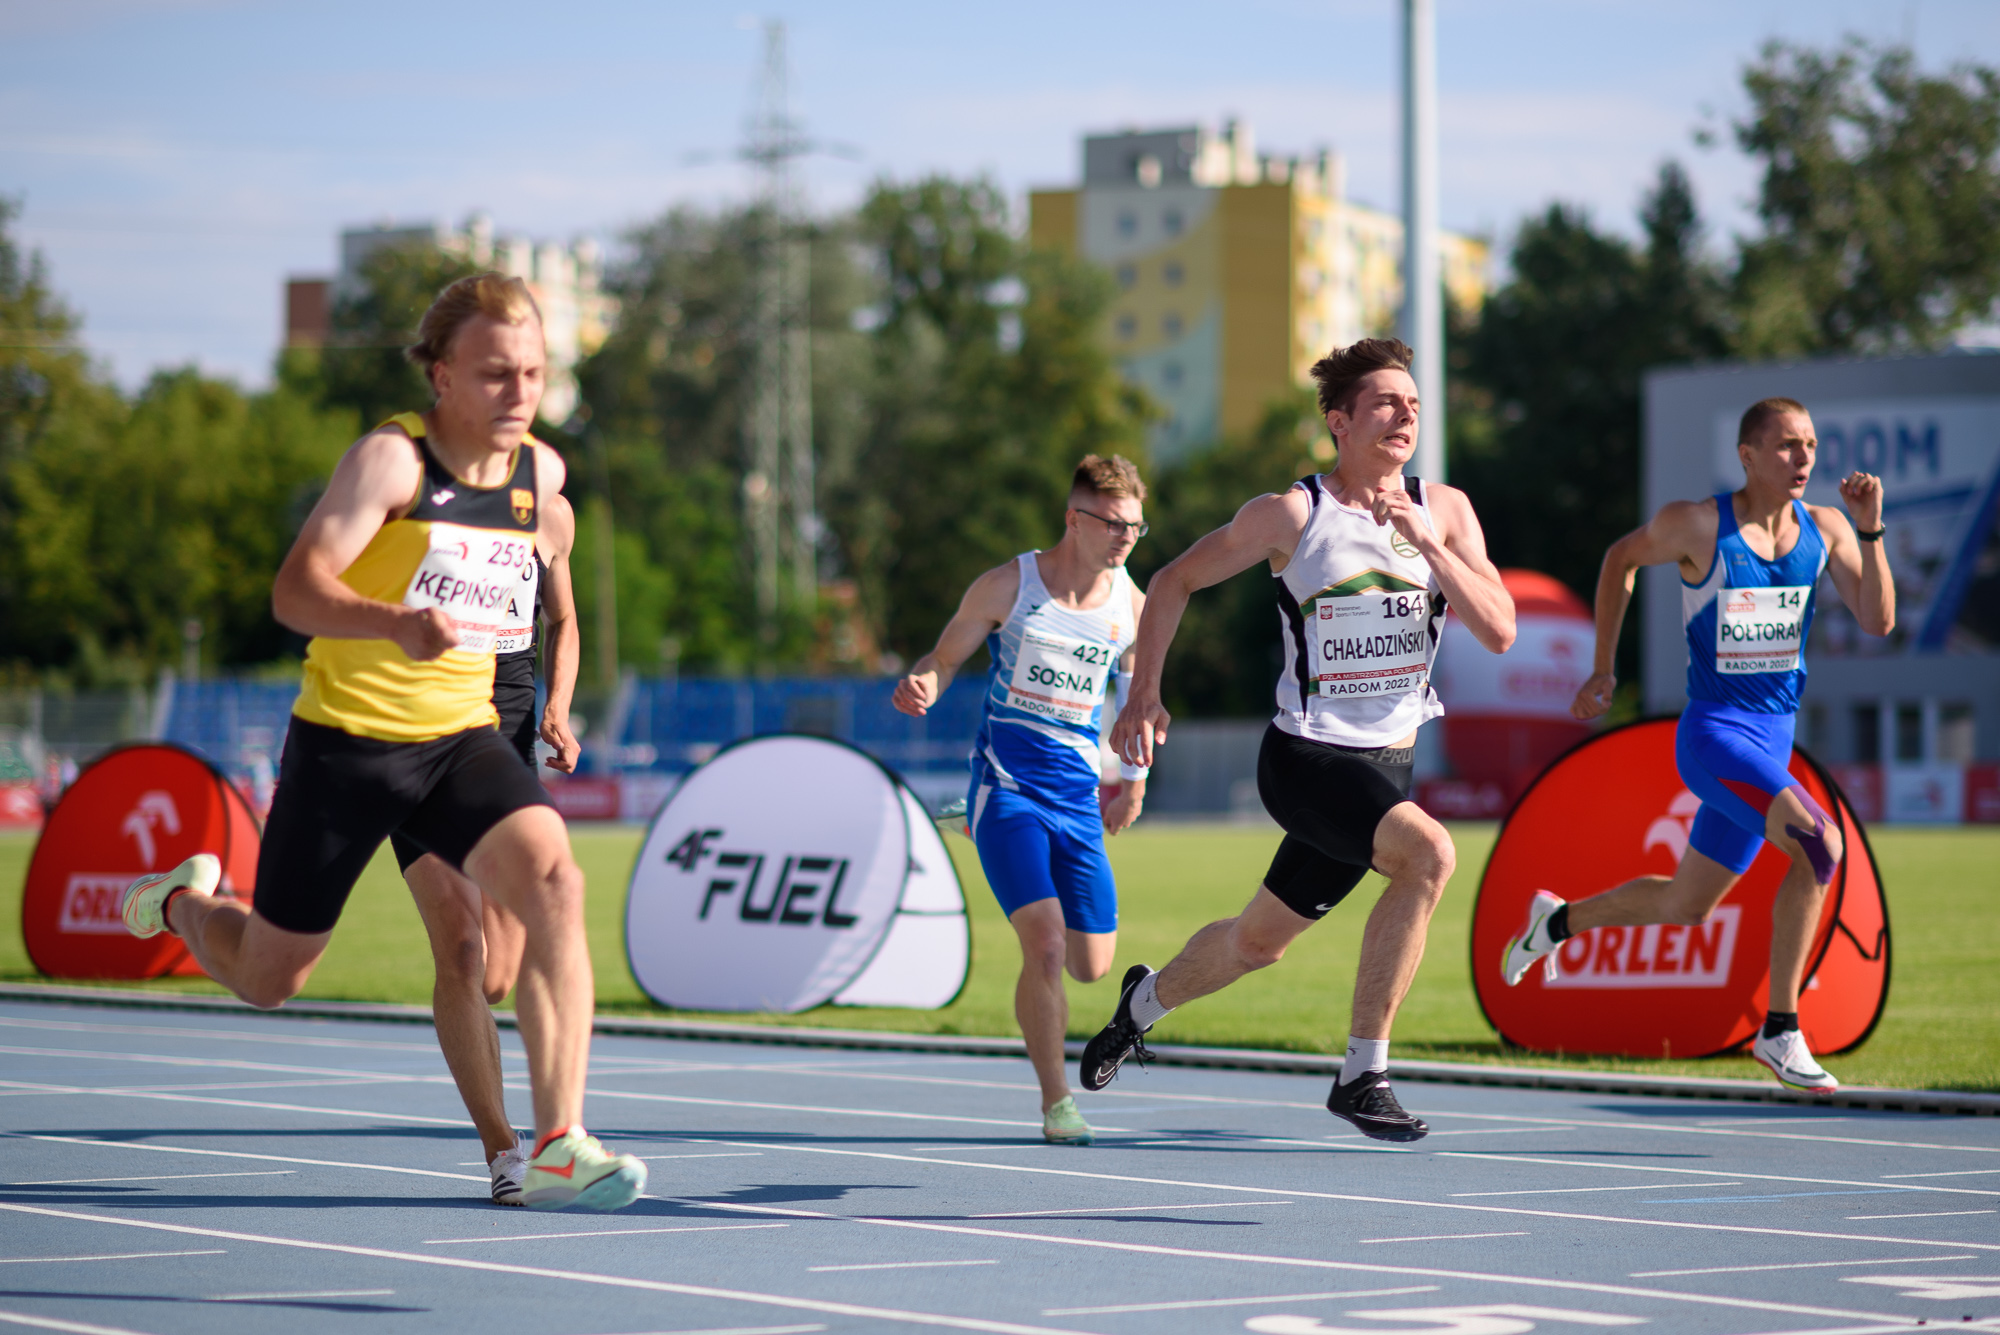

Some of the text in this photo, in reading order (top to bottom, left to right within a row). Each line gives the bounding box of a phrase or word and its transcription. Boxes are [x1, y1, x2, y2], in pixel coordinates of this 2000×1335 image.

[1819, 419, 1940, 482] DOM
[487, 540, 526, 568] 253
[414, 570, 513, 608] KĘPIŃSKI
[1777, 591, 1800, 609] 14
[1381, 594, 1424, 619] 184
[496, 639, 515, 650] 022
[1072, 645, 1110, 666] 421
[1323, 629, 1425, 661] CHAŁADZIŃSKI
[1343, 670, 1393, 679] MISTRZOSTWA
[1725, 659, 1789, 670] RADOM 2022
[1027, 664, 1093, 695] SOSNA
[1330, 678, 1410, 694] RADOM 2022
[1014, 697, 1055, 716] RADOM
[1058, 709, 1083, 721] 2022
[1378, 747, 1412, 764] PRO
[697, 852, 861, 930] FUEL
[1556, 919, 1727, 976] ORLEN
